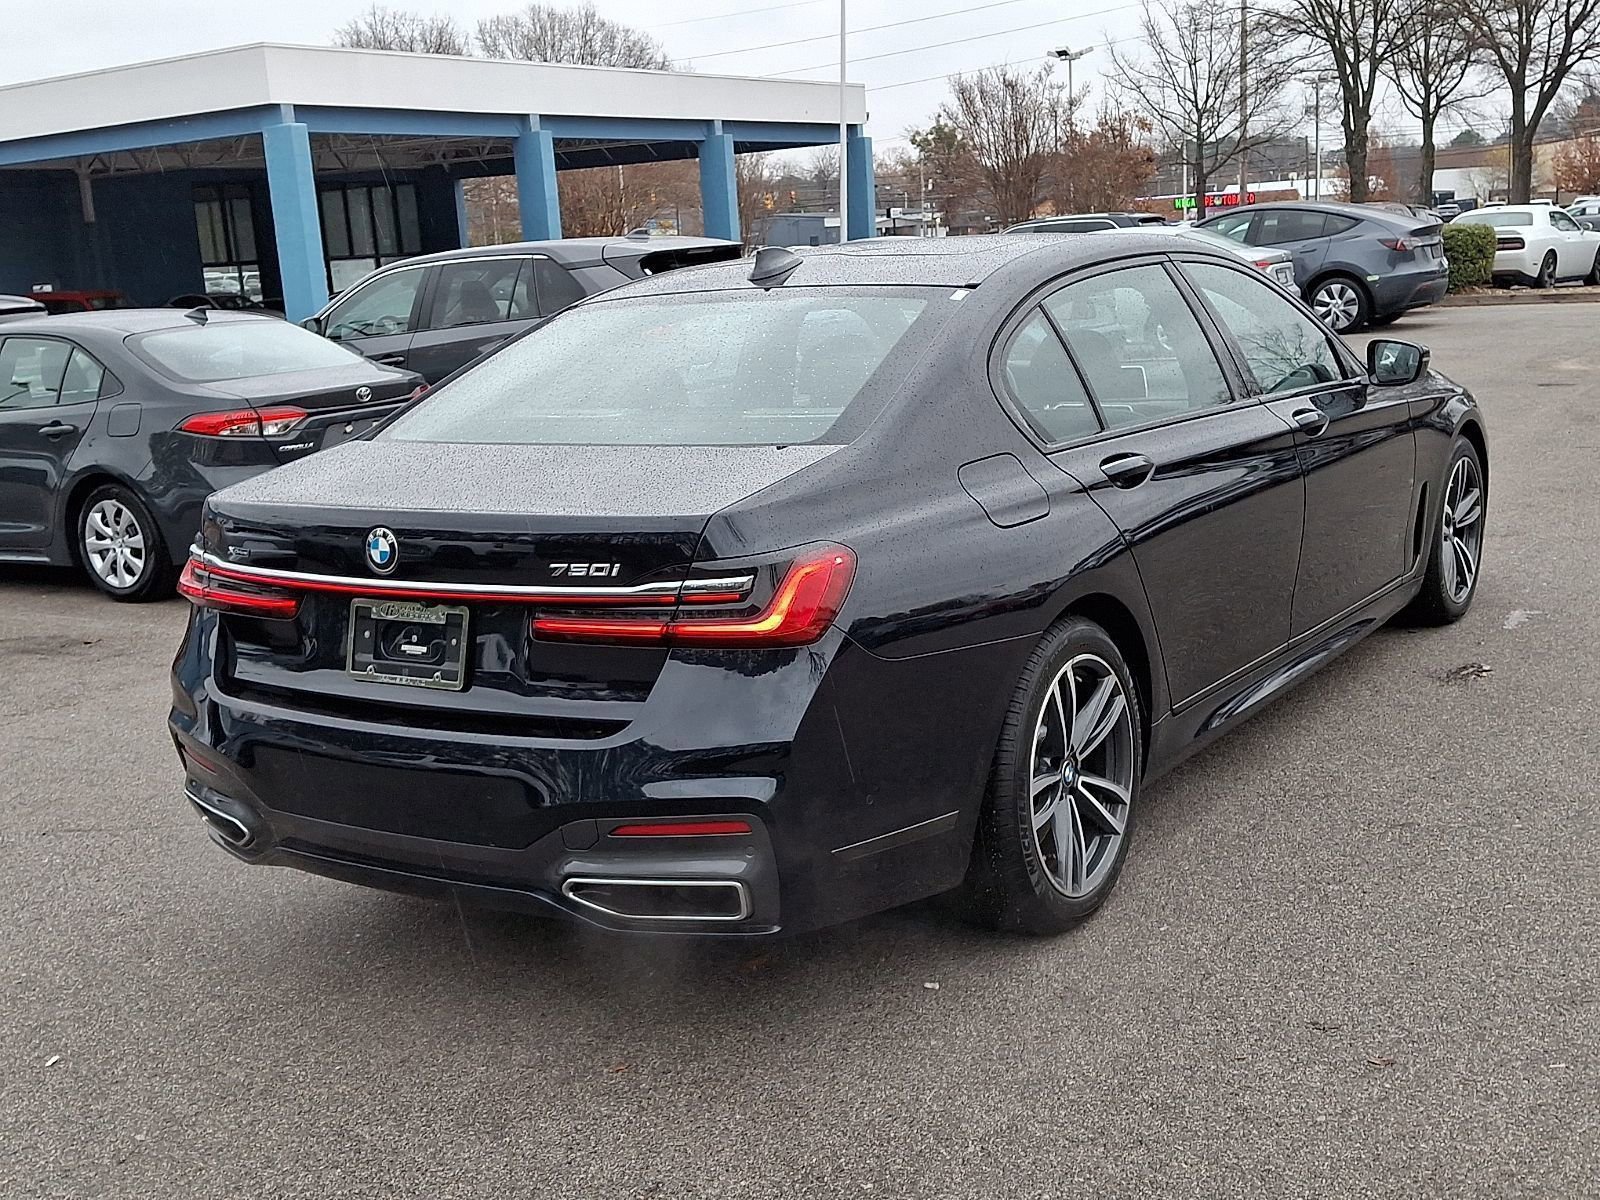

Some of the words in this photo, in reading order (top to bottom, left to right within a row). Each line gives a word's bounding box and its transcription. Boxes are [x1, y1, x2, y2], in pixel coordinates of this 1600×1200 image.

[278, 442, 314, 452] COROLLA
[367, 529, 394, 545] BMW
[548, 563, 621, 577] 750i
